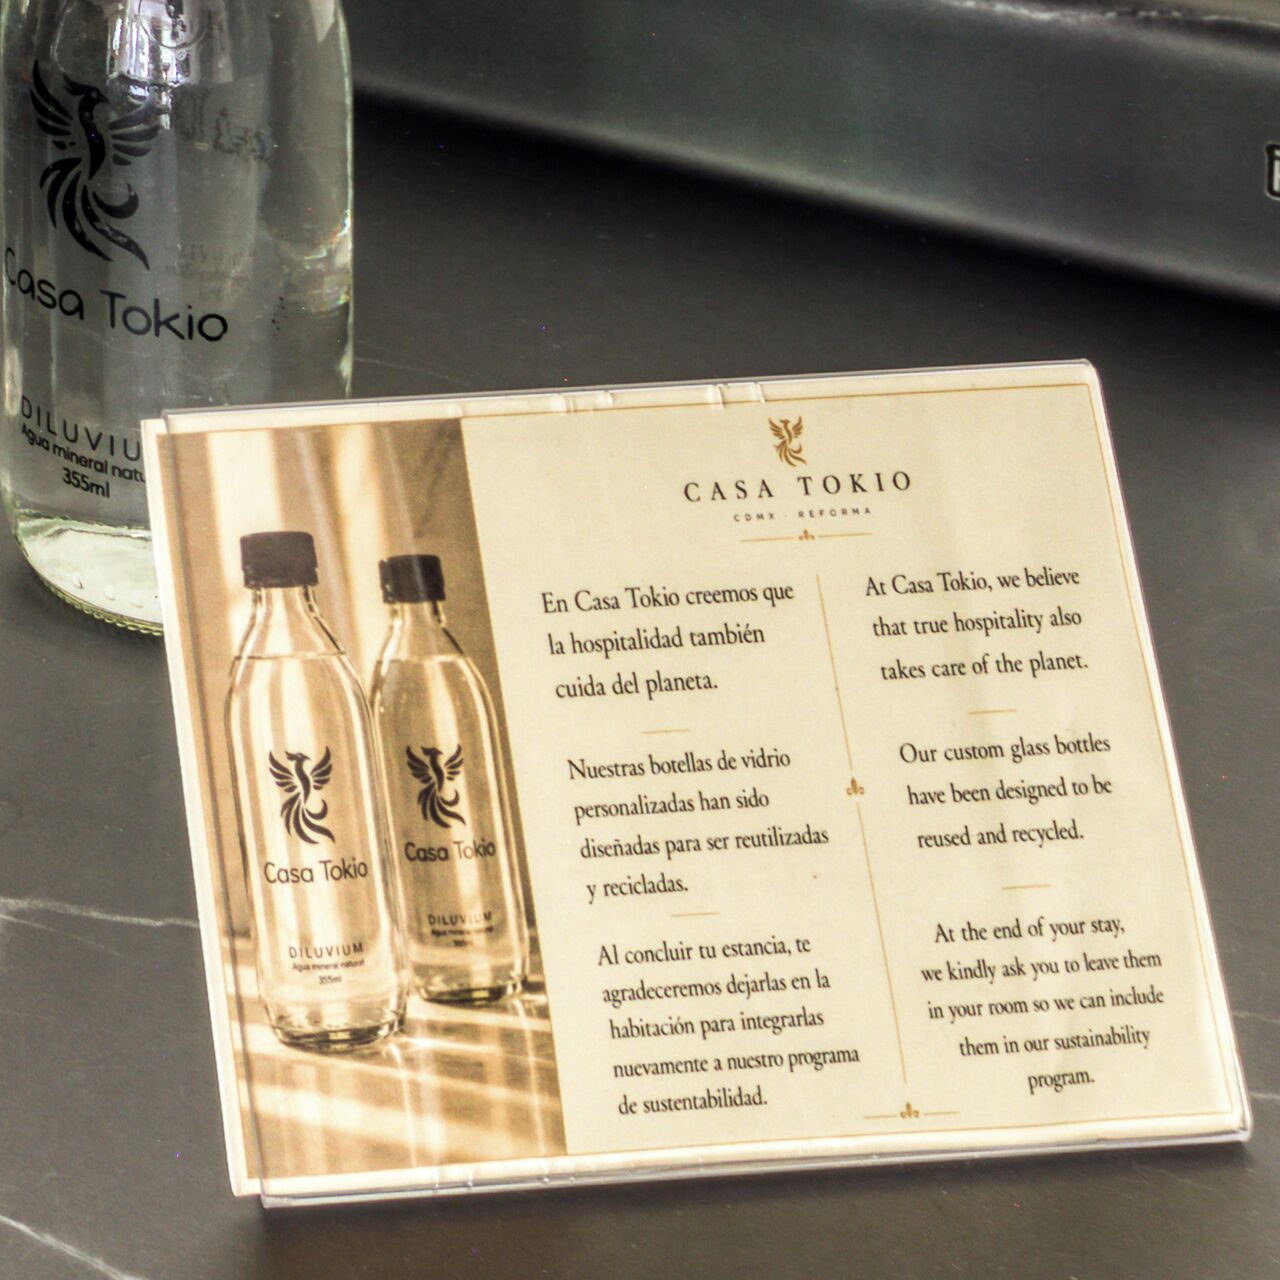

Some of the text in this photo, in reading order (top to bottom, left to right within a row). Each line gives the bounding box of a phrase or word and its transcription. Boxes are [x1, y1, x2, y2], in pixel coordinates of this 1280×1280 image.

[5, 247, 228, 342] Casa Tokio
[22, 394, 140, 461] DILUVIU
[22, 423, 50, 452] Agua
[52, 443, 108, 474] mineral
[63, 466, 110, 498] 355ml
[684, 472, 910, 502] CASA TOKIO
[734, 506, 872, 522] CDMX REFORMA
[866, 566, 1079, 596] At Casa Tokio, we believe
[542, 586, 793, 613] En Casa Tokio creemos que
[873, 606, 1081, 637] that true hospitality also
[548, 623, 765, 659] la hospitalidad también
[881, 651, 1088, 680] takes care of the planet.
[556, 670, 718, 700] cuida del planeta.
[900, 732, 1110, 763] Our custom glass bottles
[567, 748, 790, 779] Nuestras botellas de vidrio
[907, 774, 1111, 805] have been designed to be
[574, 787, 769, 826] personalizadas han sido
[580, 824, 829, 860] diseñadas para ser reutilizadas
[917, 819, 1083, 848] reused and recycled.
[404, 838, 496, 862] Casa Tokio
[264, 857, 368, 884] Casa Tokio
[587, 872, 688, 904] y recicladas.
[935, 916, 1124, 943] At the end of your stay,
[289, 942, 364, 959] DILUVIUM
[599, 936, 810, 966] Al concluir tu estancia, te
[921, 949, 1162, 984] we kindly ask you to leave them
[603, 968, 830, 1008] agradeceremos dejarlas en la
[928, 985, 1163, 1024] in your room so we can include
[609, 1006, 824, 1040] habitación para integrarlas
[959, 1025, 1150, 1056] them in our sustainability
[613, 1050, 859, 1077] nuevamente a nuestro programa
[1028, 1071, 1094, 1095] program.
[618, 1085, 767, 1115] de sustentabilidad.
